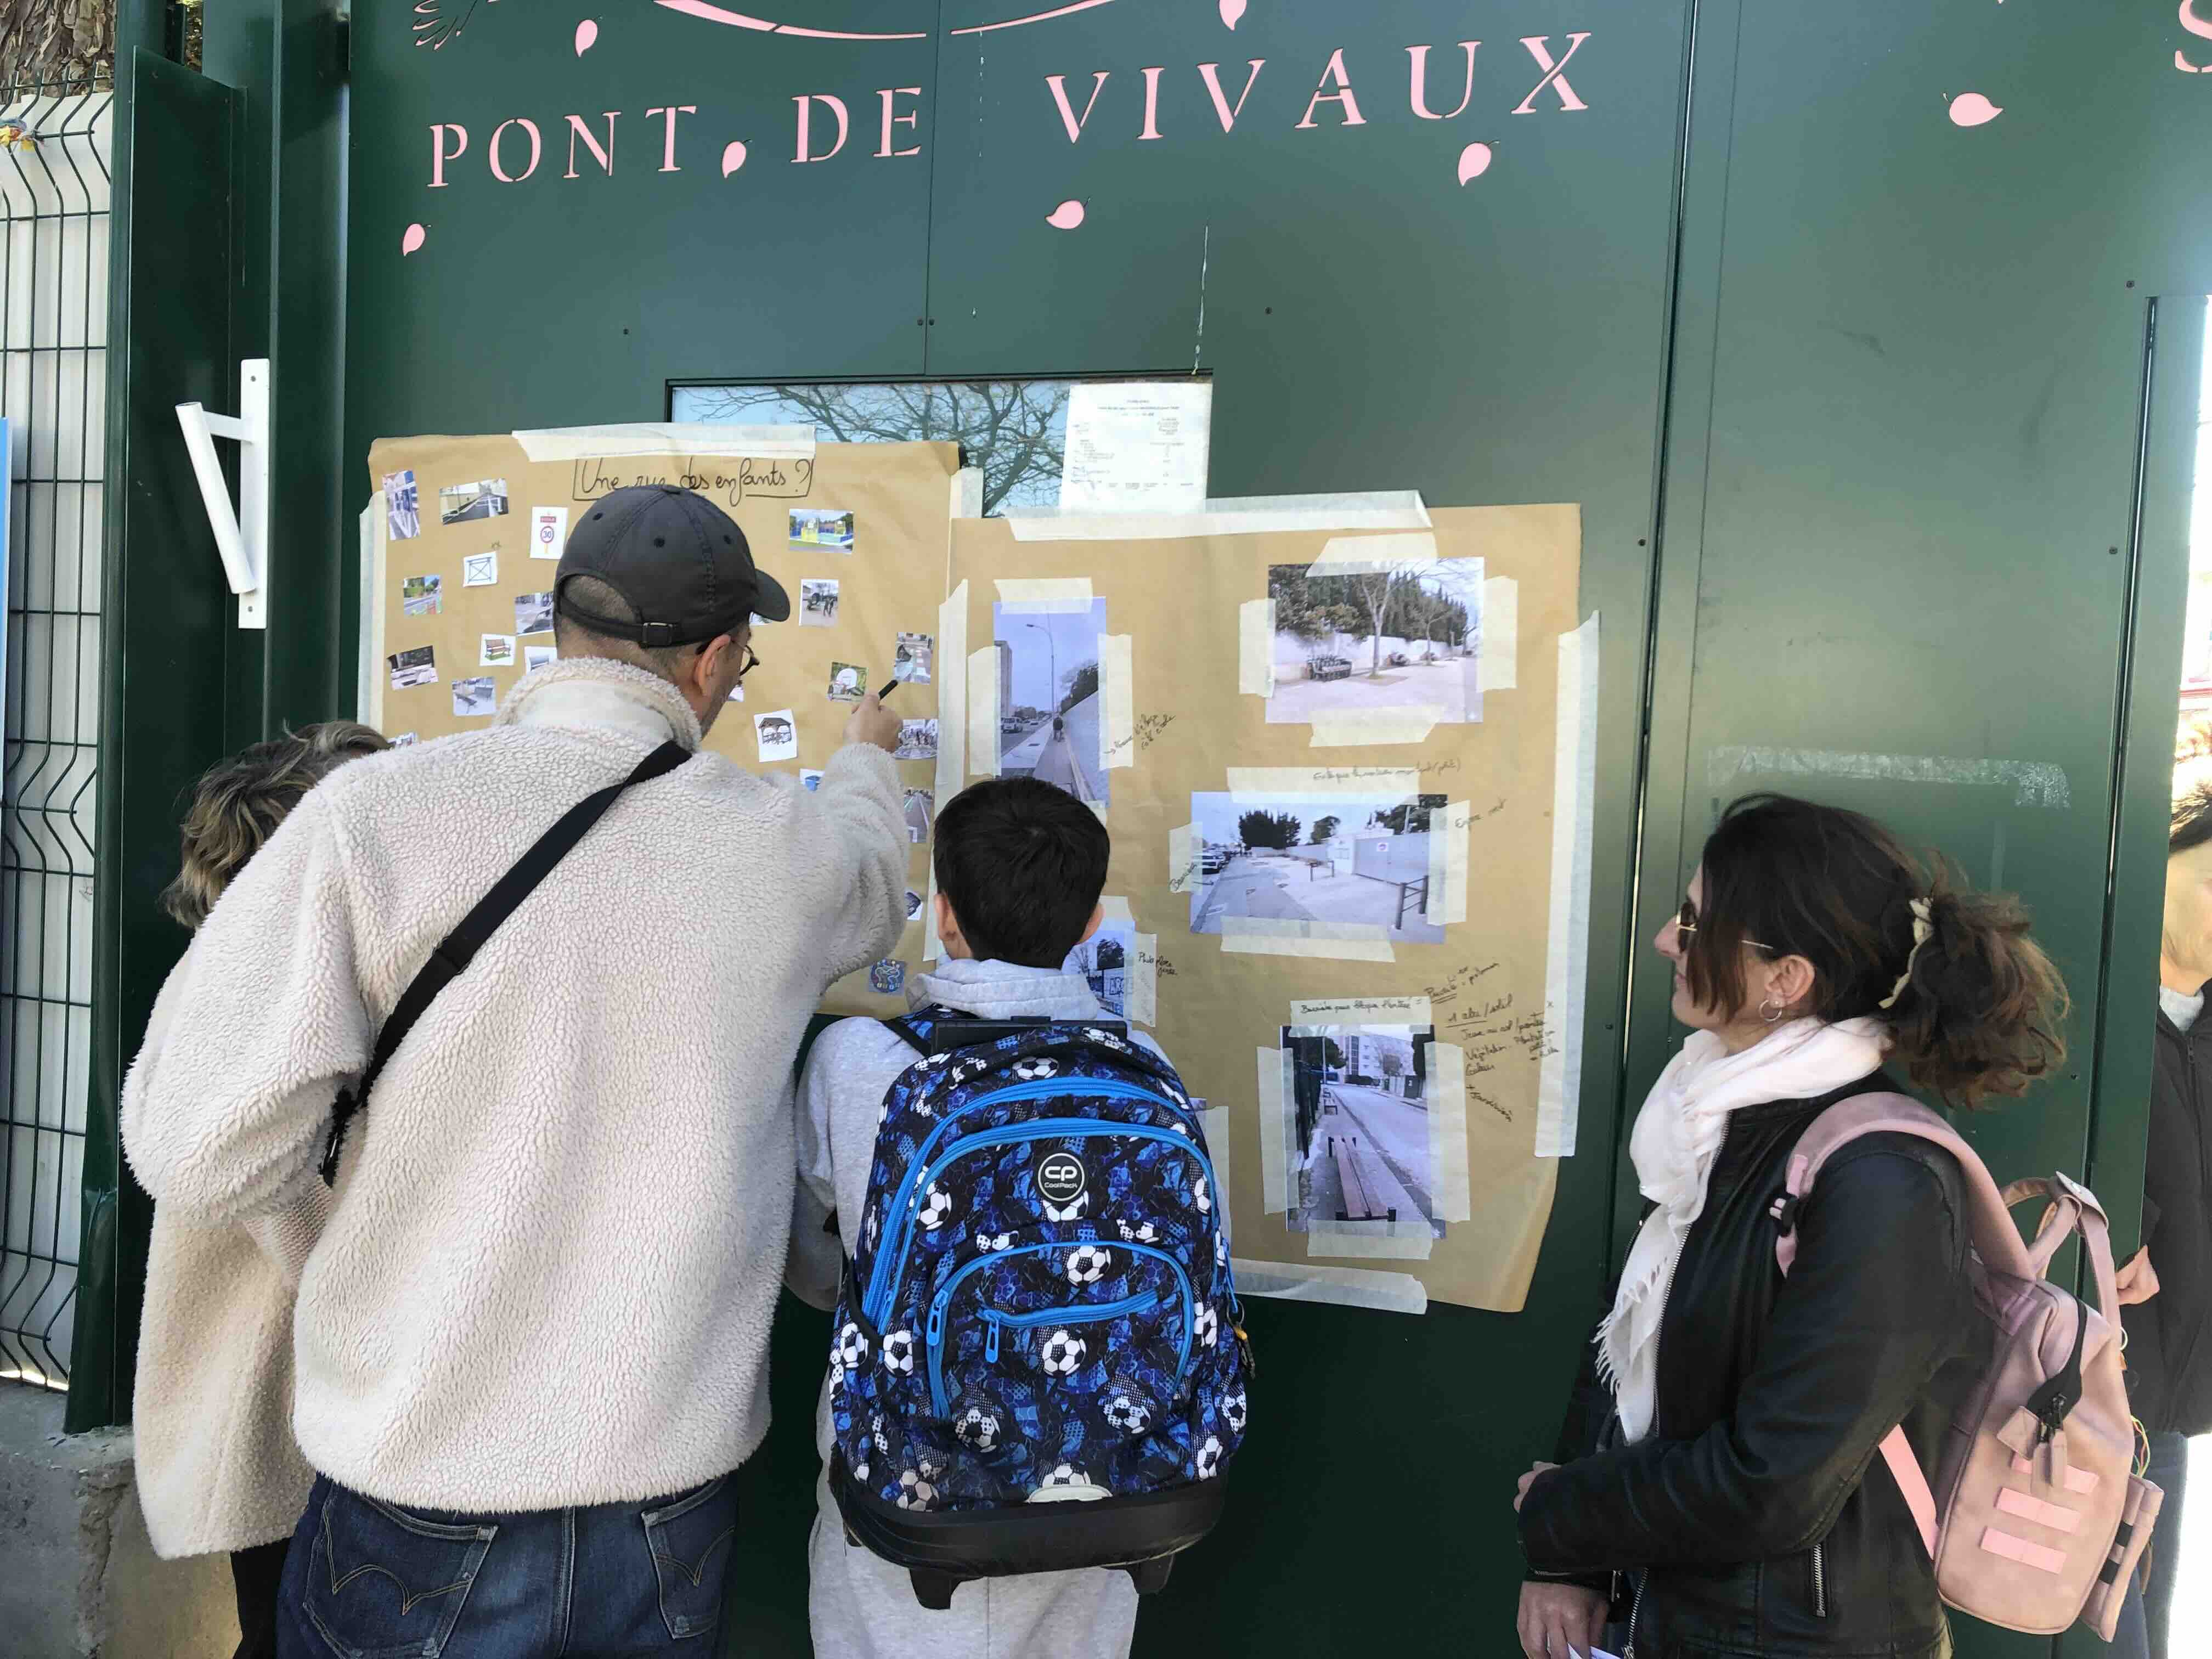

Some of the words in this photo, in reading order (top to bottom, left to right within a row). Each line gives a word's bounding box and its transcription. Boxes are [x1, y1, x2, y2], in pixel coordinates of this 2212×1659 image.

[427, 105, 697, 187] PONT
[790, 87, 922, 163] DE
[1045, 31, 1592, 144] VIVAUX
[582, 456, 625, 493] Une
[636, 474, 666, 487] rue
[680, 456, 710, 489] des
[715, 458, 787, 506] enfants
